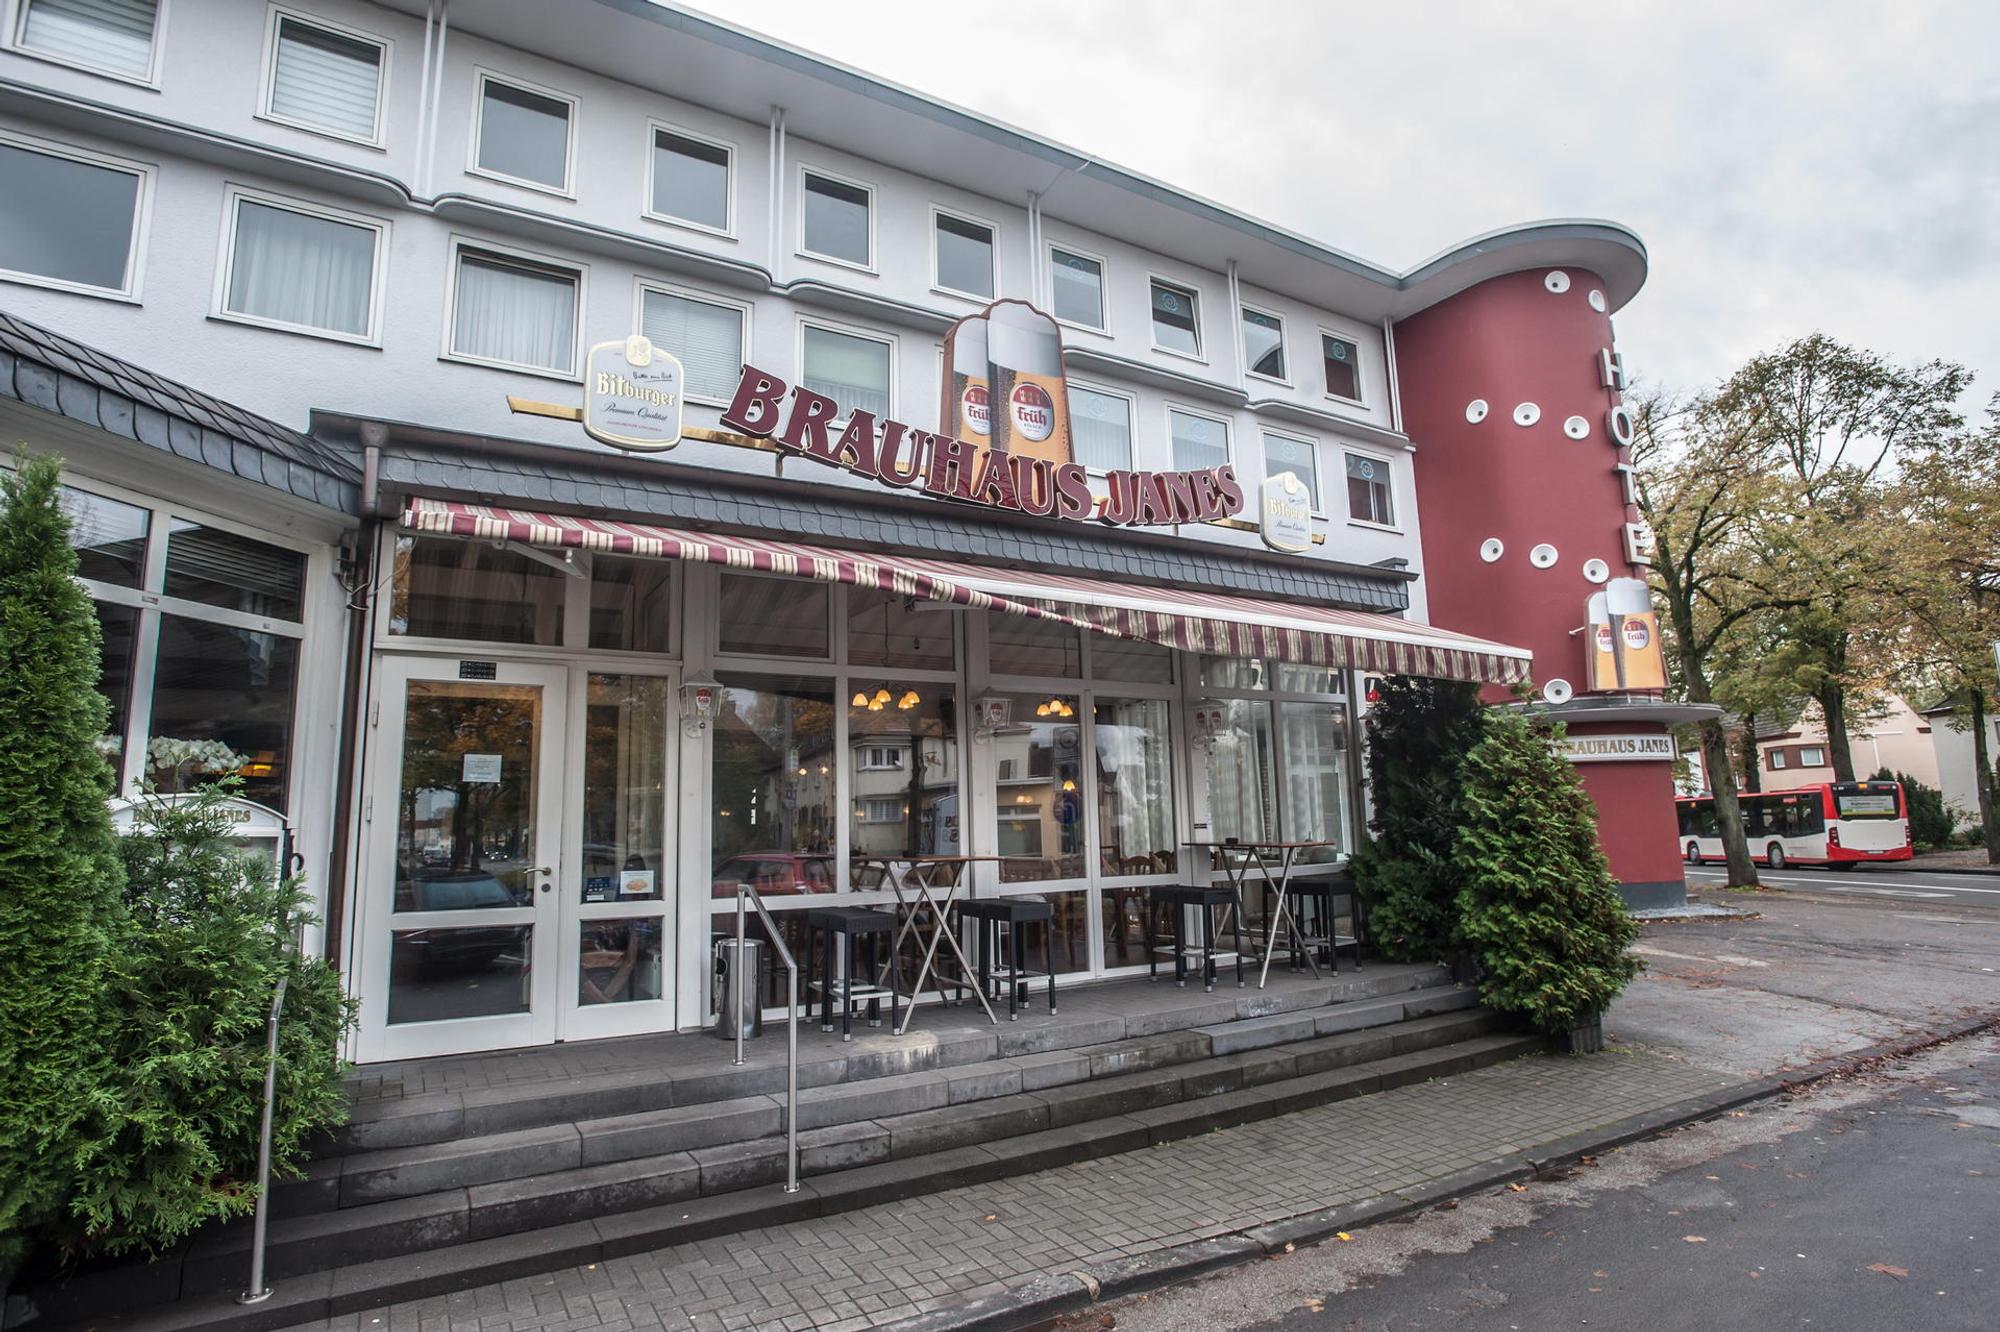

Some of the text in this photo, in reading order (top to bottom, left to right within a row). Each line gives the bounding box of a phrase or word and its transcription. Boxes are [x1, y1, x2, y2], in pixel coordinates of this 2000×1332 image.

[596, 371, 677, 408] Bitburger
[720, 364, 1244, 526] BRAUHAUS JANES
[1600, 348, 1652, 564] HOTE
[1567, 739, 1670, 755] RAUHAUS JANES
